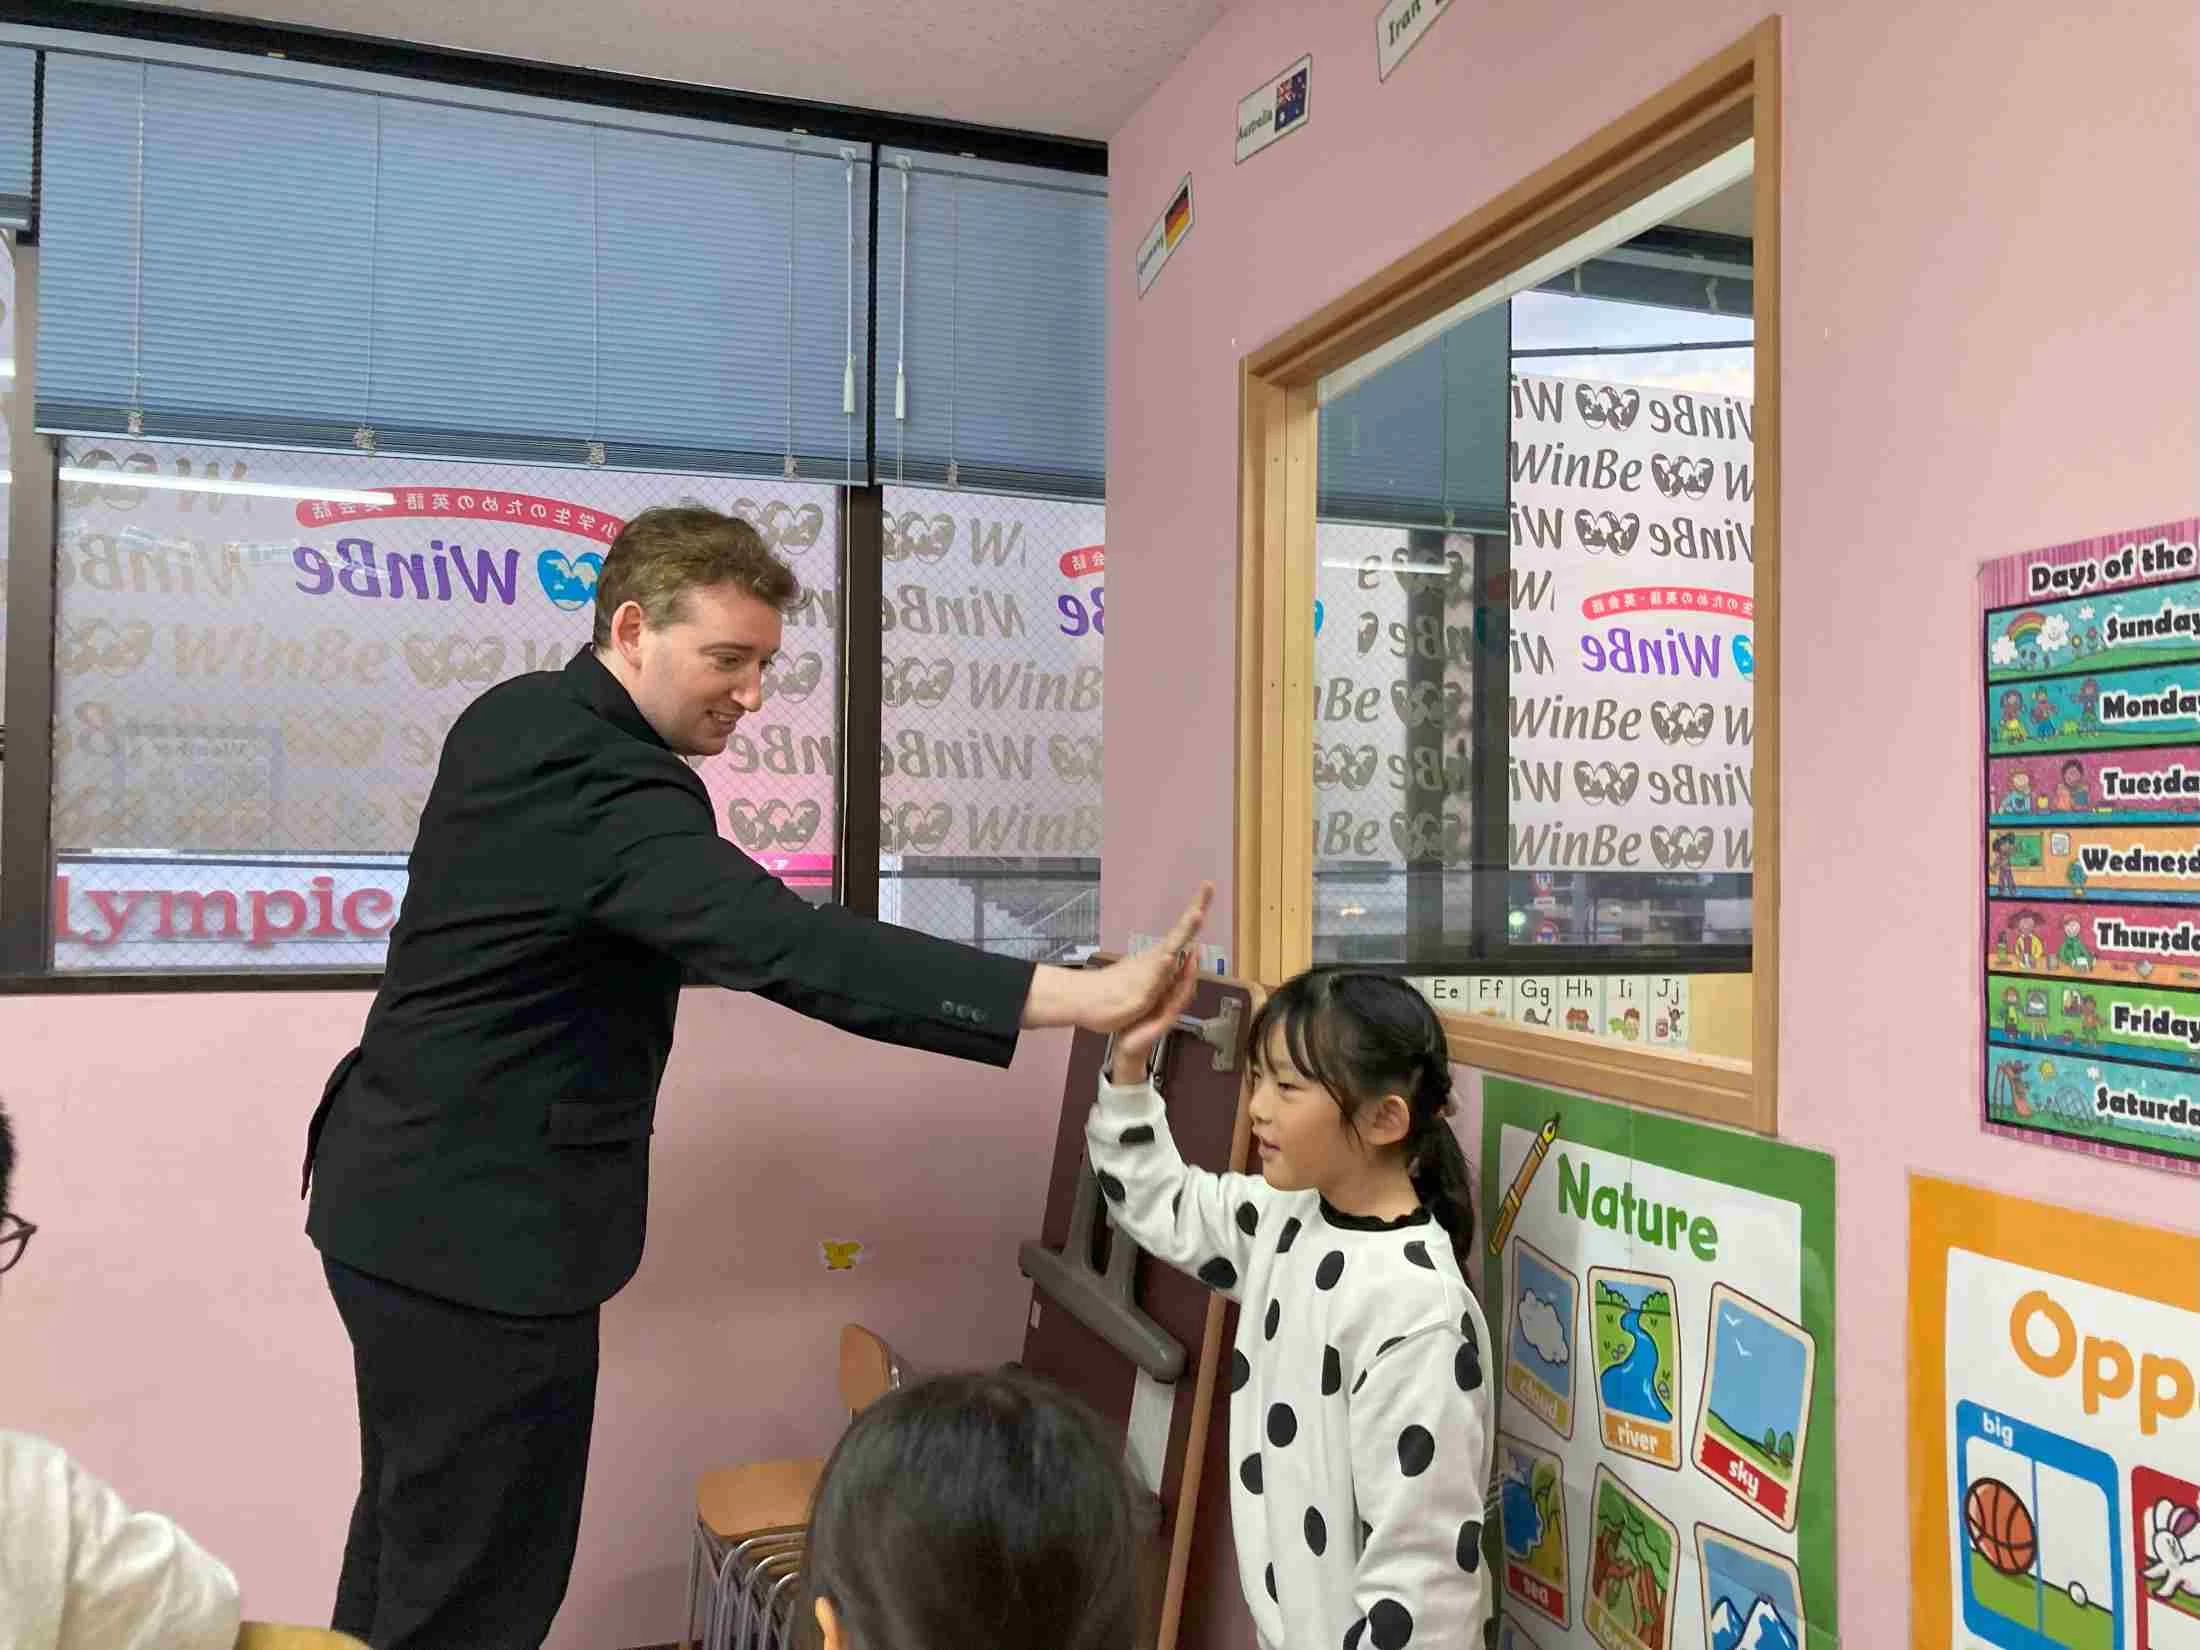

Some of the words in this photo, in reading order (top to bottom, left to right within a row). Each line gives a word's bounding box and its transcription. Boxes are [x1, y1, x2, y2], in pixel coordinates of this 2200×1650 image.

[1389, 0, 1422, 46] Iran
[1510, 441, 1643, 493] WinBe
[2031, 564, 2096, 592] Days
[2104, 549, 2134, 579] of
[2142, 543, 2193, 572] the
[1509, 694, 1642, 742] WinBe
[2103, 689, 2200, 719] Monda
[1509, 820, 1642, 867] WinBe
[1433, 979, 1459, 1000] Ee
[1479, 979, 1503, 1000] Ff
[1520, 979, 1550, 1006] Gg
[1566, 979, 1592, 999] Hh
[1618, 979, 1632, 999] Ii
[1656, 979, 1679, 1006] Jj
[1557, 1152, 1719, 1262] Nature
[1616, 1420, 1658, 1453] river
[1982, 1411, 2014, 1449] big
[1727, 1459, 1759, 1500] sky
